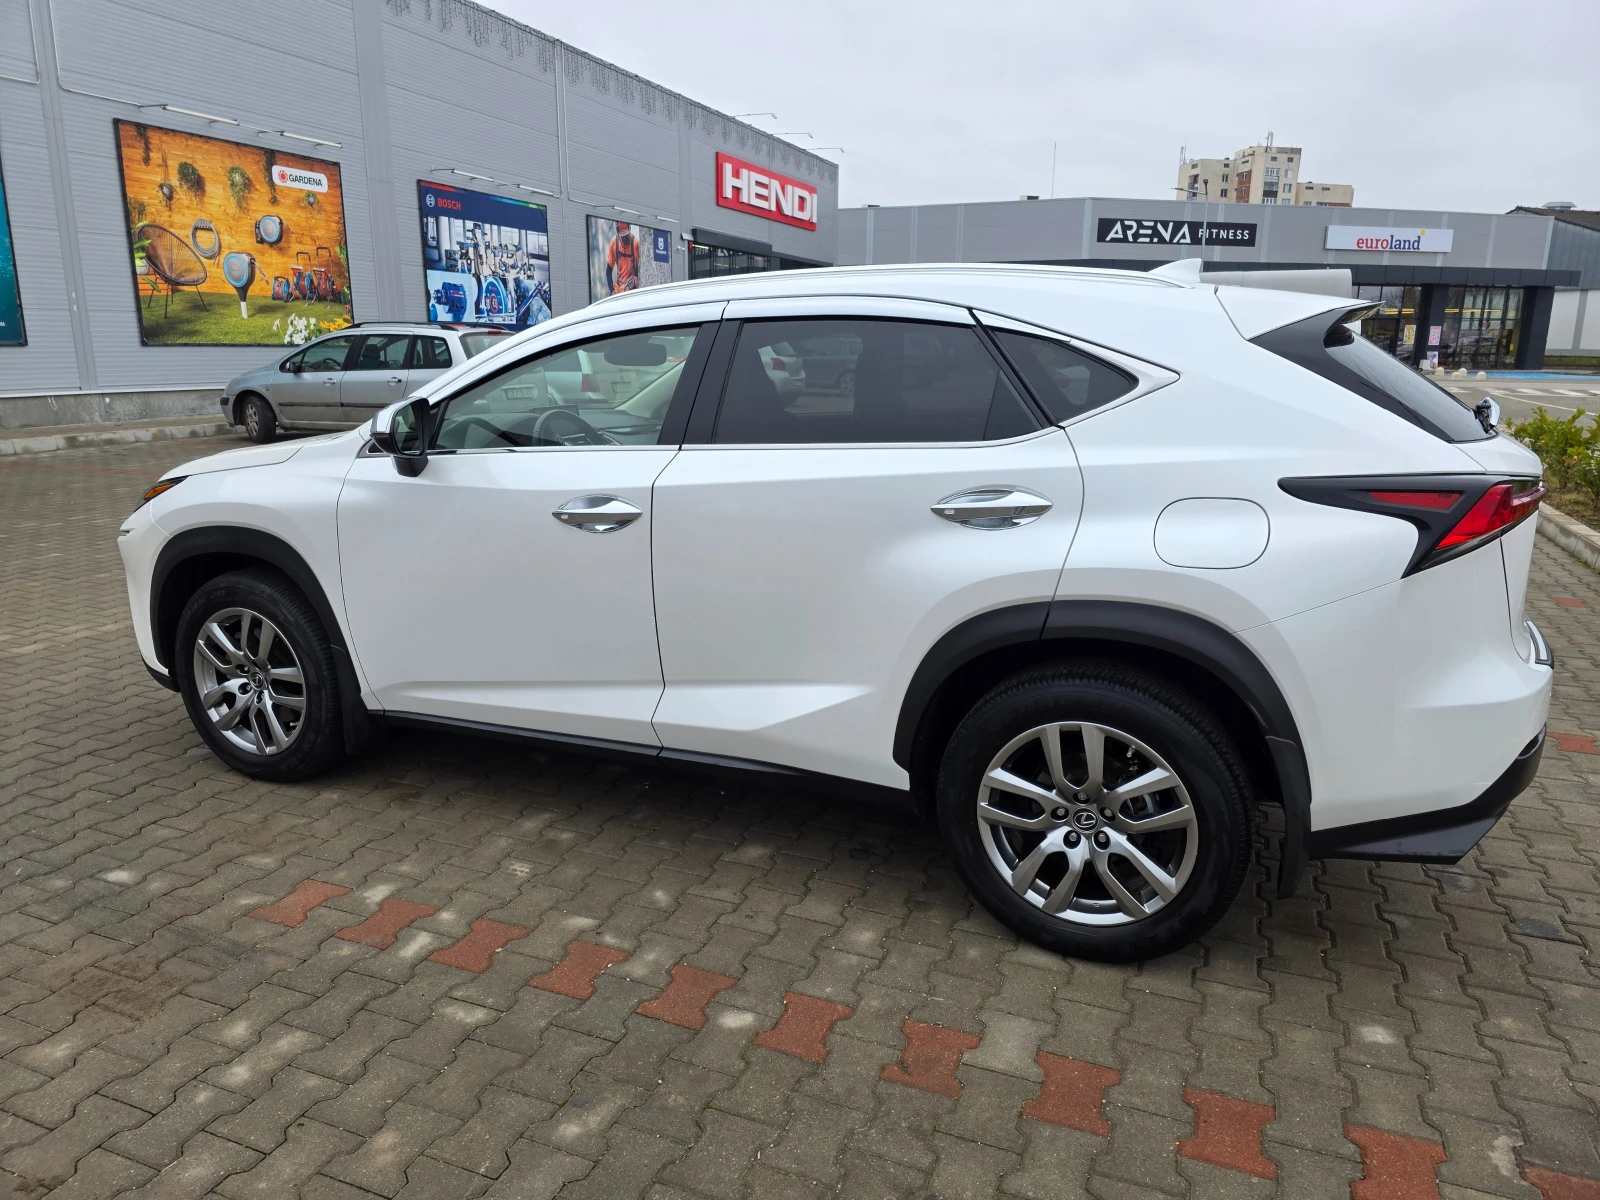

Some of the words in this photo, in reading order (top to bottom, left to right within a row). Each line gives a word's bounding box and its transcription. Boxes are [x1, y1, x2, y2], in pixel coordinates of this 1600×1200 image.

[288, 173, 323, 187] GARDENA
[723, 162, 818, 224] HENDI
[437, 197, 462, 211] BOSCH
[1105, 220, 1192, 244] ARENA
[1198, 228, 1250, 240] FITNESS
[1356, 234, 1421, 251] euroland
